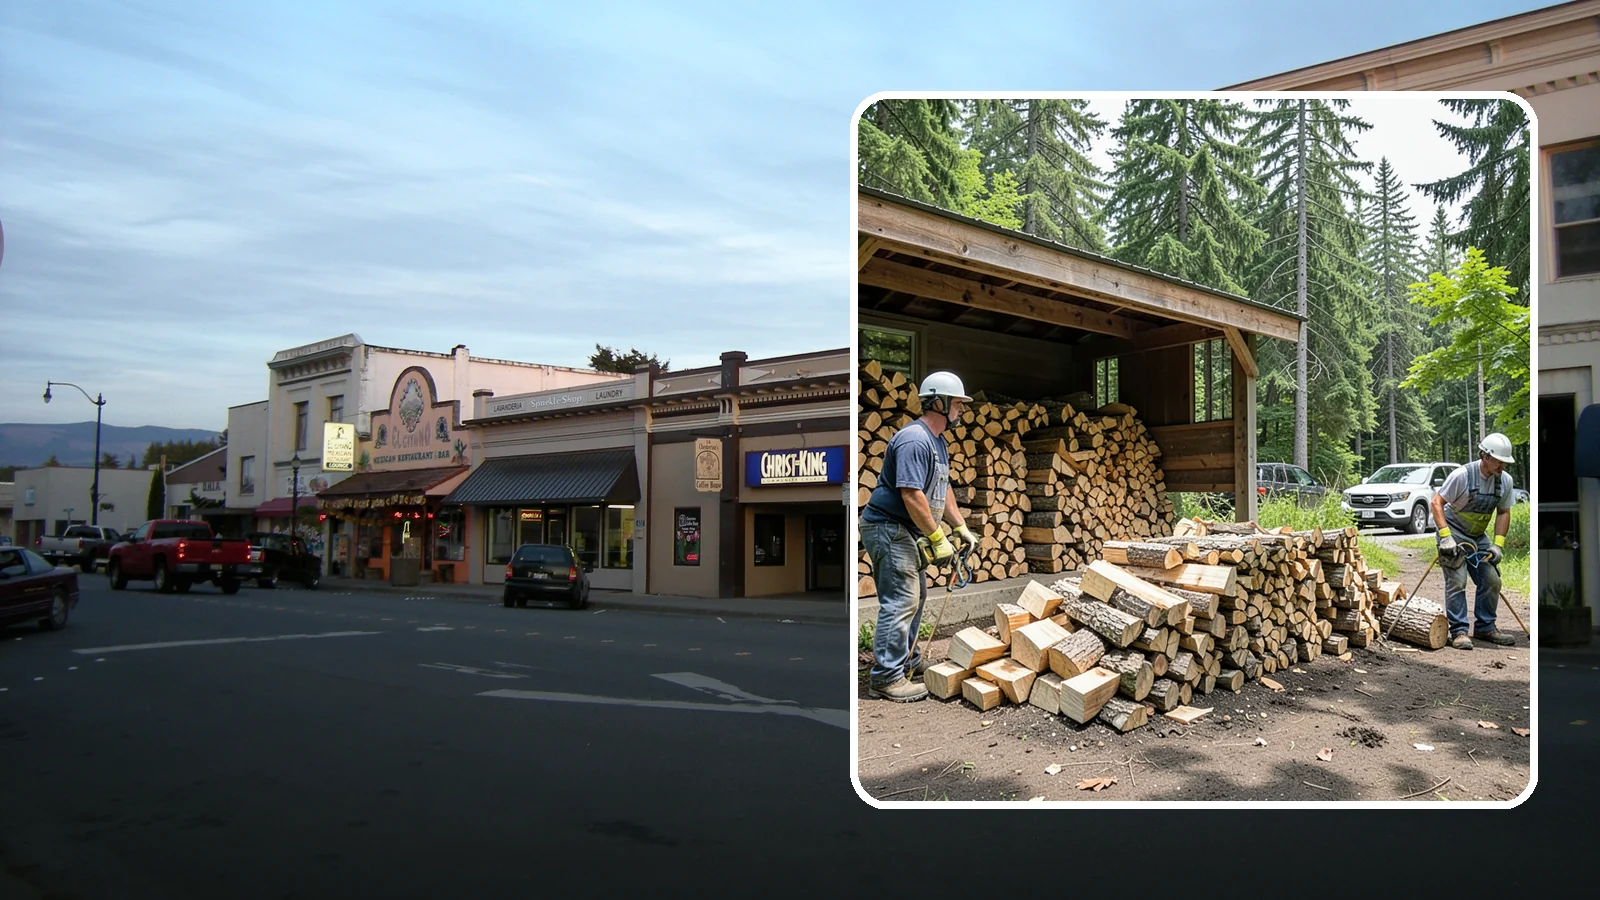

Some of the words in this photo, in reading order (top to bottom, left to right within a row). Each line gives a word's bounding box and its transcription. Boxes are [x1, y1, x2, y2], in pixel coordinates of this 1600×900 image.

[562, 394, 582, 405] Shop
[596, 388, 623, 400] LAUNDRY
[493, 402, 522, 412] LAVANDERIA
[373, 454, 396, 464] MEXICAN
[397, 451, 433, 462] RESTAURANT
[437, 450, 450, 459] BAR
[761, 452, 797, 477] CHRIST
[799, 450, 827, 476] KING
[697, 481, 709, 489] Coffee
[710, 481, 721, 489] House
